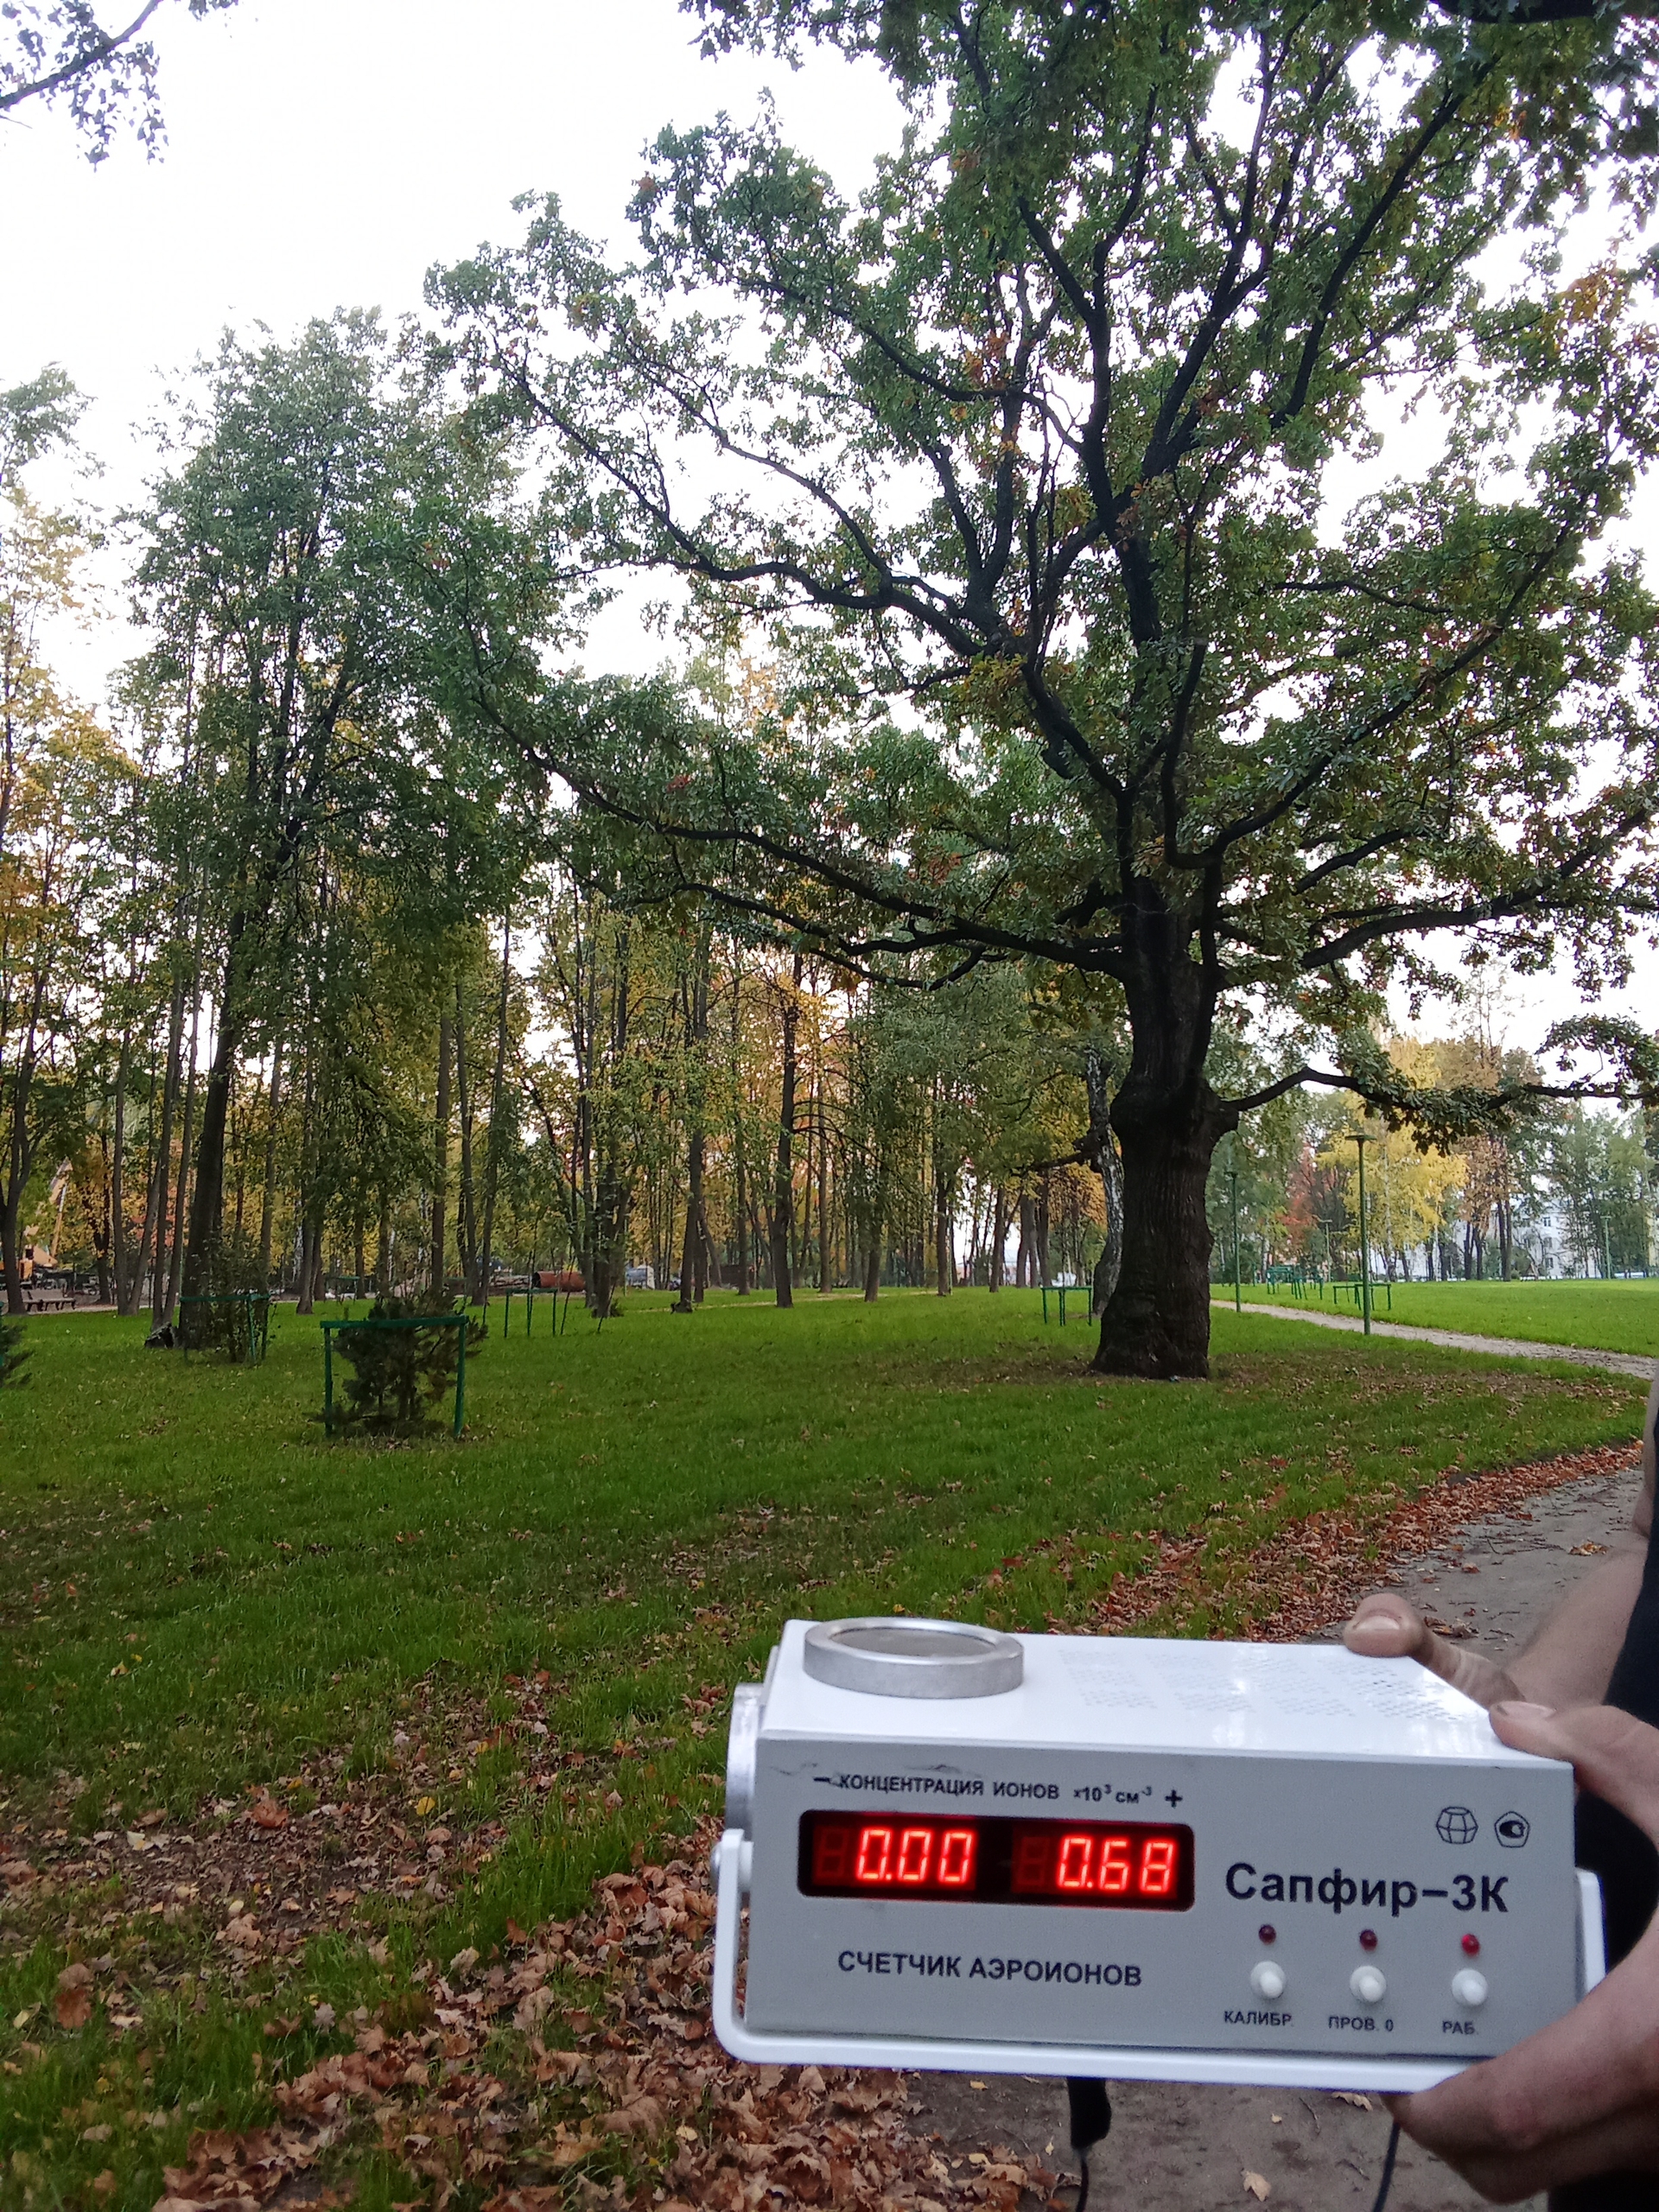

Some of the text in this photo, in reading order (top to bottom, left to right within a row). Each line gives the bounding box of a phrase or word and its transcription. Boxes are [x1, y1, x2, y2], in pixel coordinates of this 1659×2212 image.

[840, 1774, 984, 1797] КОНЦЕНТРАЦИЯ
[992, 1781, 1060, 1800] ИОНОВ
[856, 1827, 1176, 1893] 0.00 0.68
[1224, 1861, 1510, 1918] Сапфир-3К
[837, 1950, 1143, 1987] СЧЕТЧИК АЭРОИОНОВ
